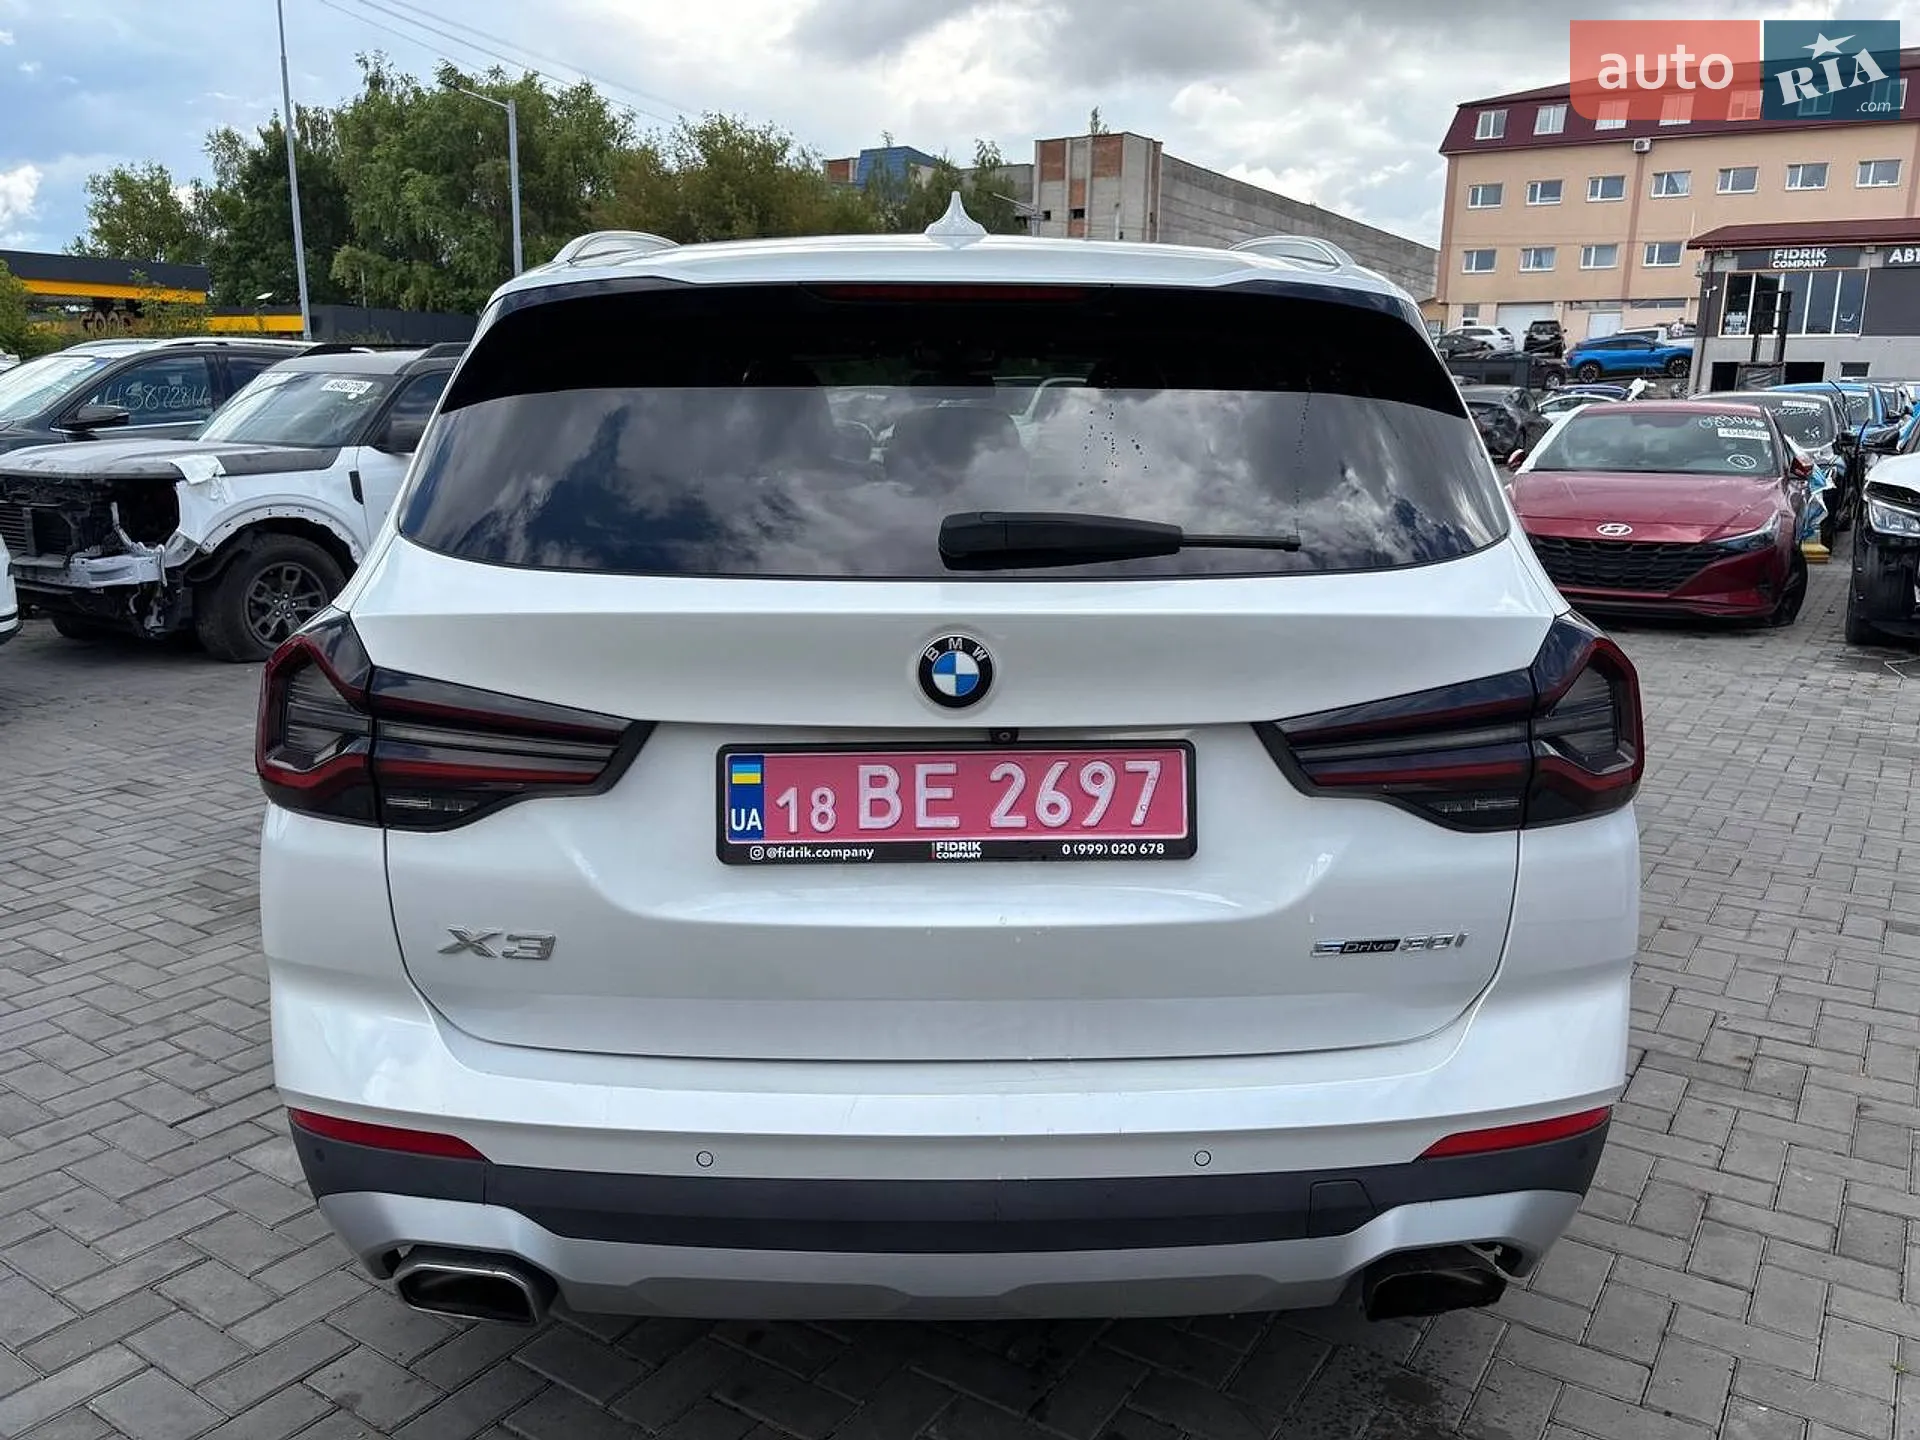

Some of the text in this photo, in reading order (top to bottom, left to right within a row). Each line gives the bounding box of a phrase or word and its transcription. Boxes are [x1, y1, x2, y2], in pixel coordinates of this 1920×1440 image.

[1773, 248, 1827, 260] FIDRIK
[1772, 259, 1827, 269] COMPANY
[925, 638, 988, 662] BMW
[775, 760, 1162, 834] 18 BE 2697
[731, 808, 763, 832] UA
[766, 846, 875, 860] @fidrik.company
[936, 842, 982, 852] FIDRIK
[1062, 843, 1165, 856] 0 (999) 020 678
[935, 851, 982, 860] COMPANY
[437, 925, 556, 960] X3
